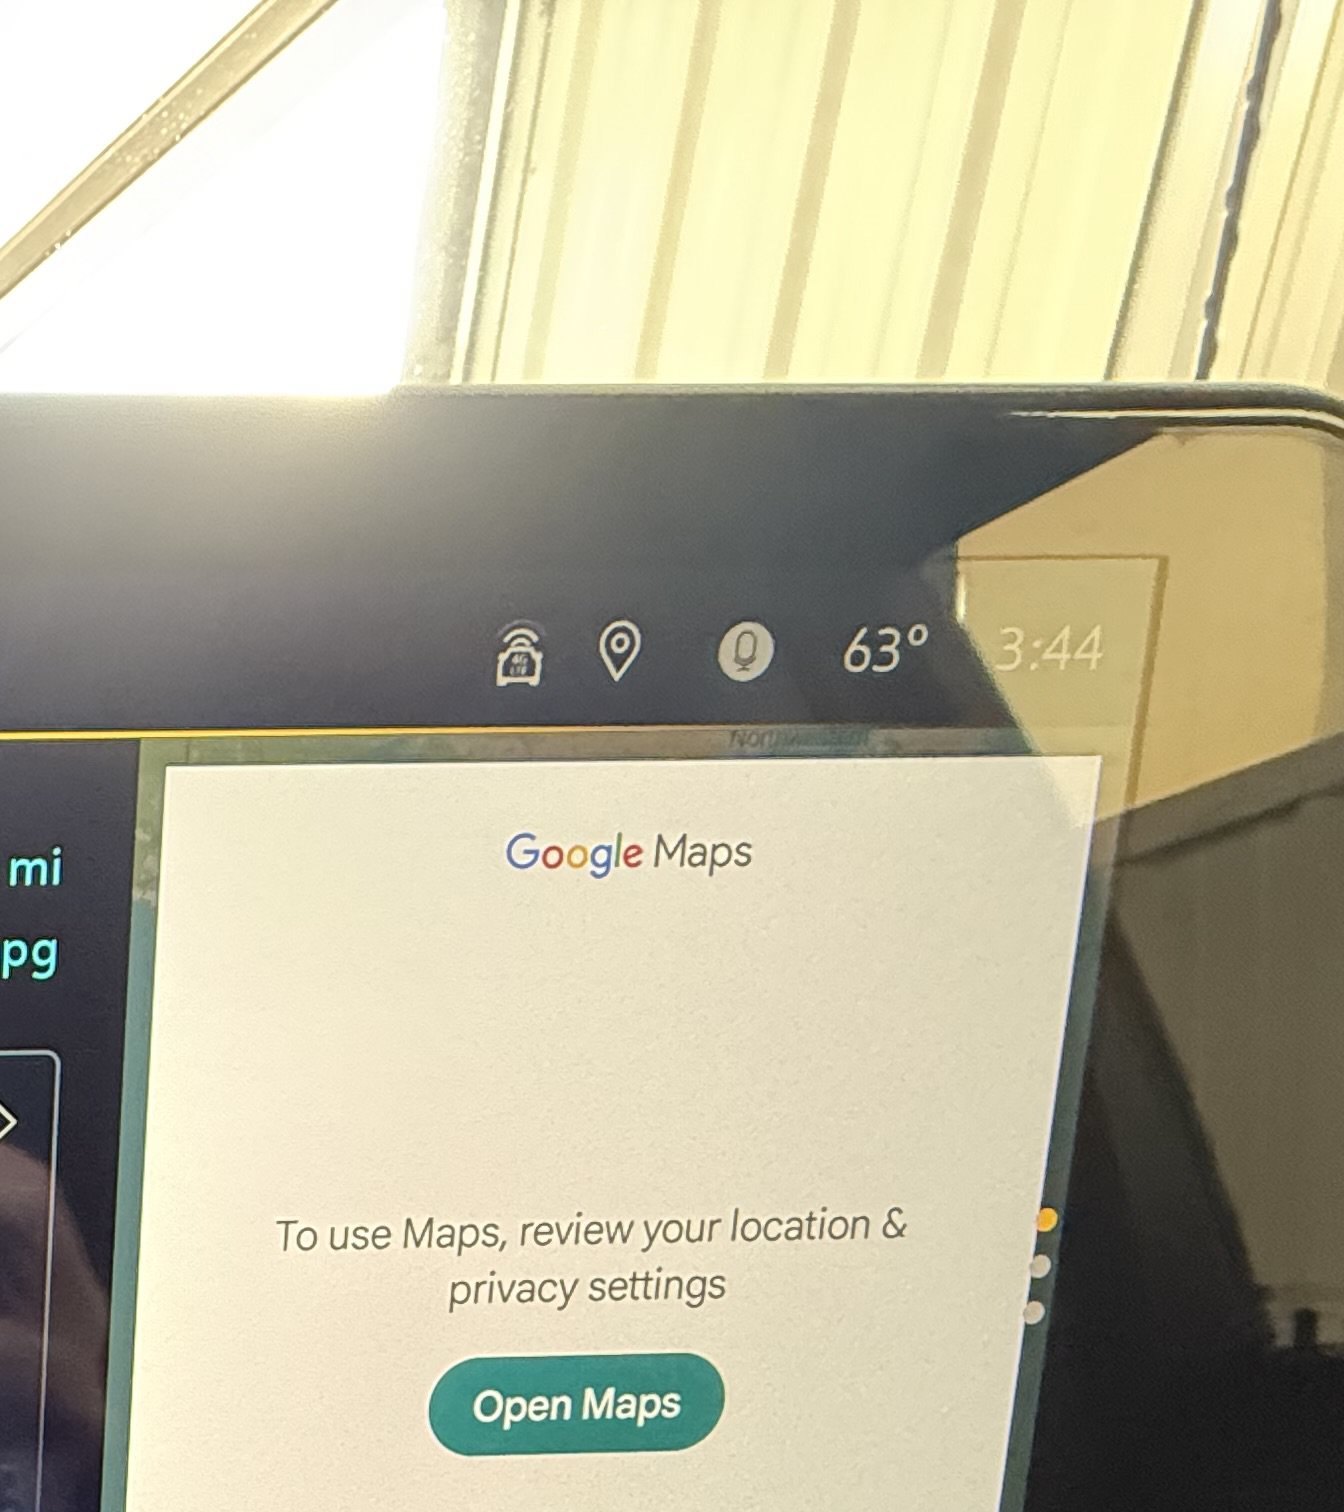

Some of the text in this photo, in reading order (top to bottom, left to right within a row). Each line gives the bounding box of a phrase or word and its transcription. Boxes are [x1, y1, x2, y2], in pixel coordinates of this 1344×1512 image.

[995, 624, 1104, 671] 3:44
[9, 847, 62, 887] mi
[506, 832, 752, 879] Google Maps
[276, 1206, 908, 1257] To use Maps, review your location &
[448, 1266, 726, 1314] privacy settings
[473, 1386, 681, 1431] Open Maps
